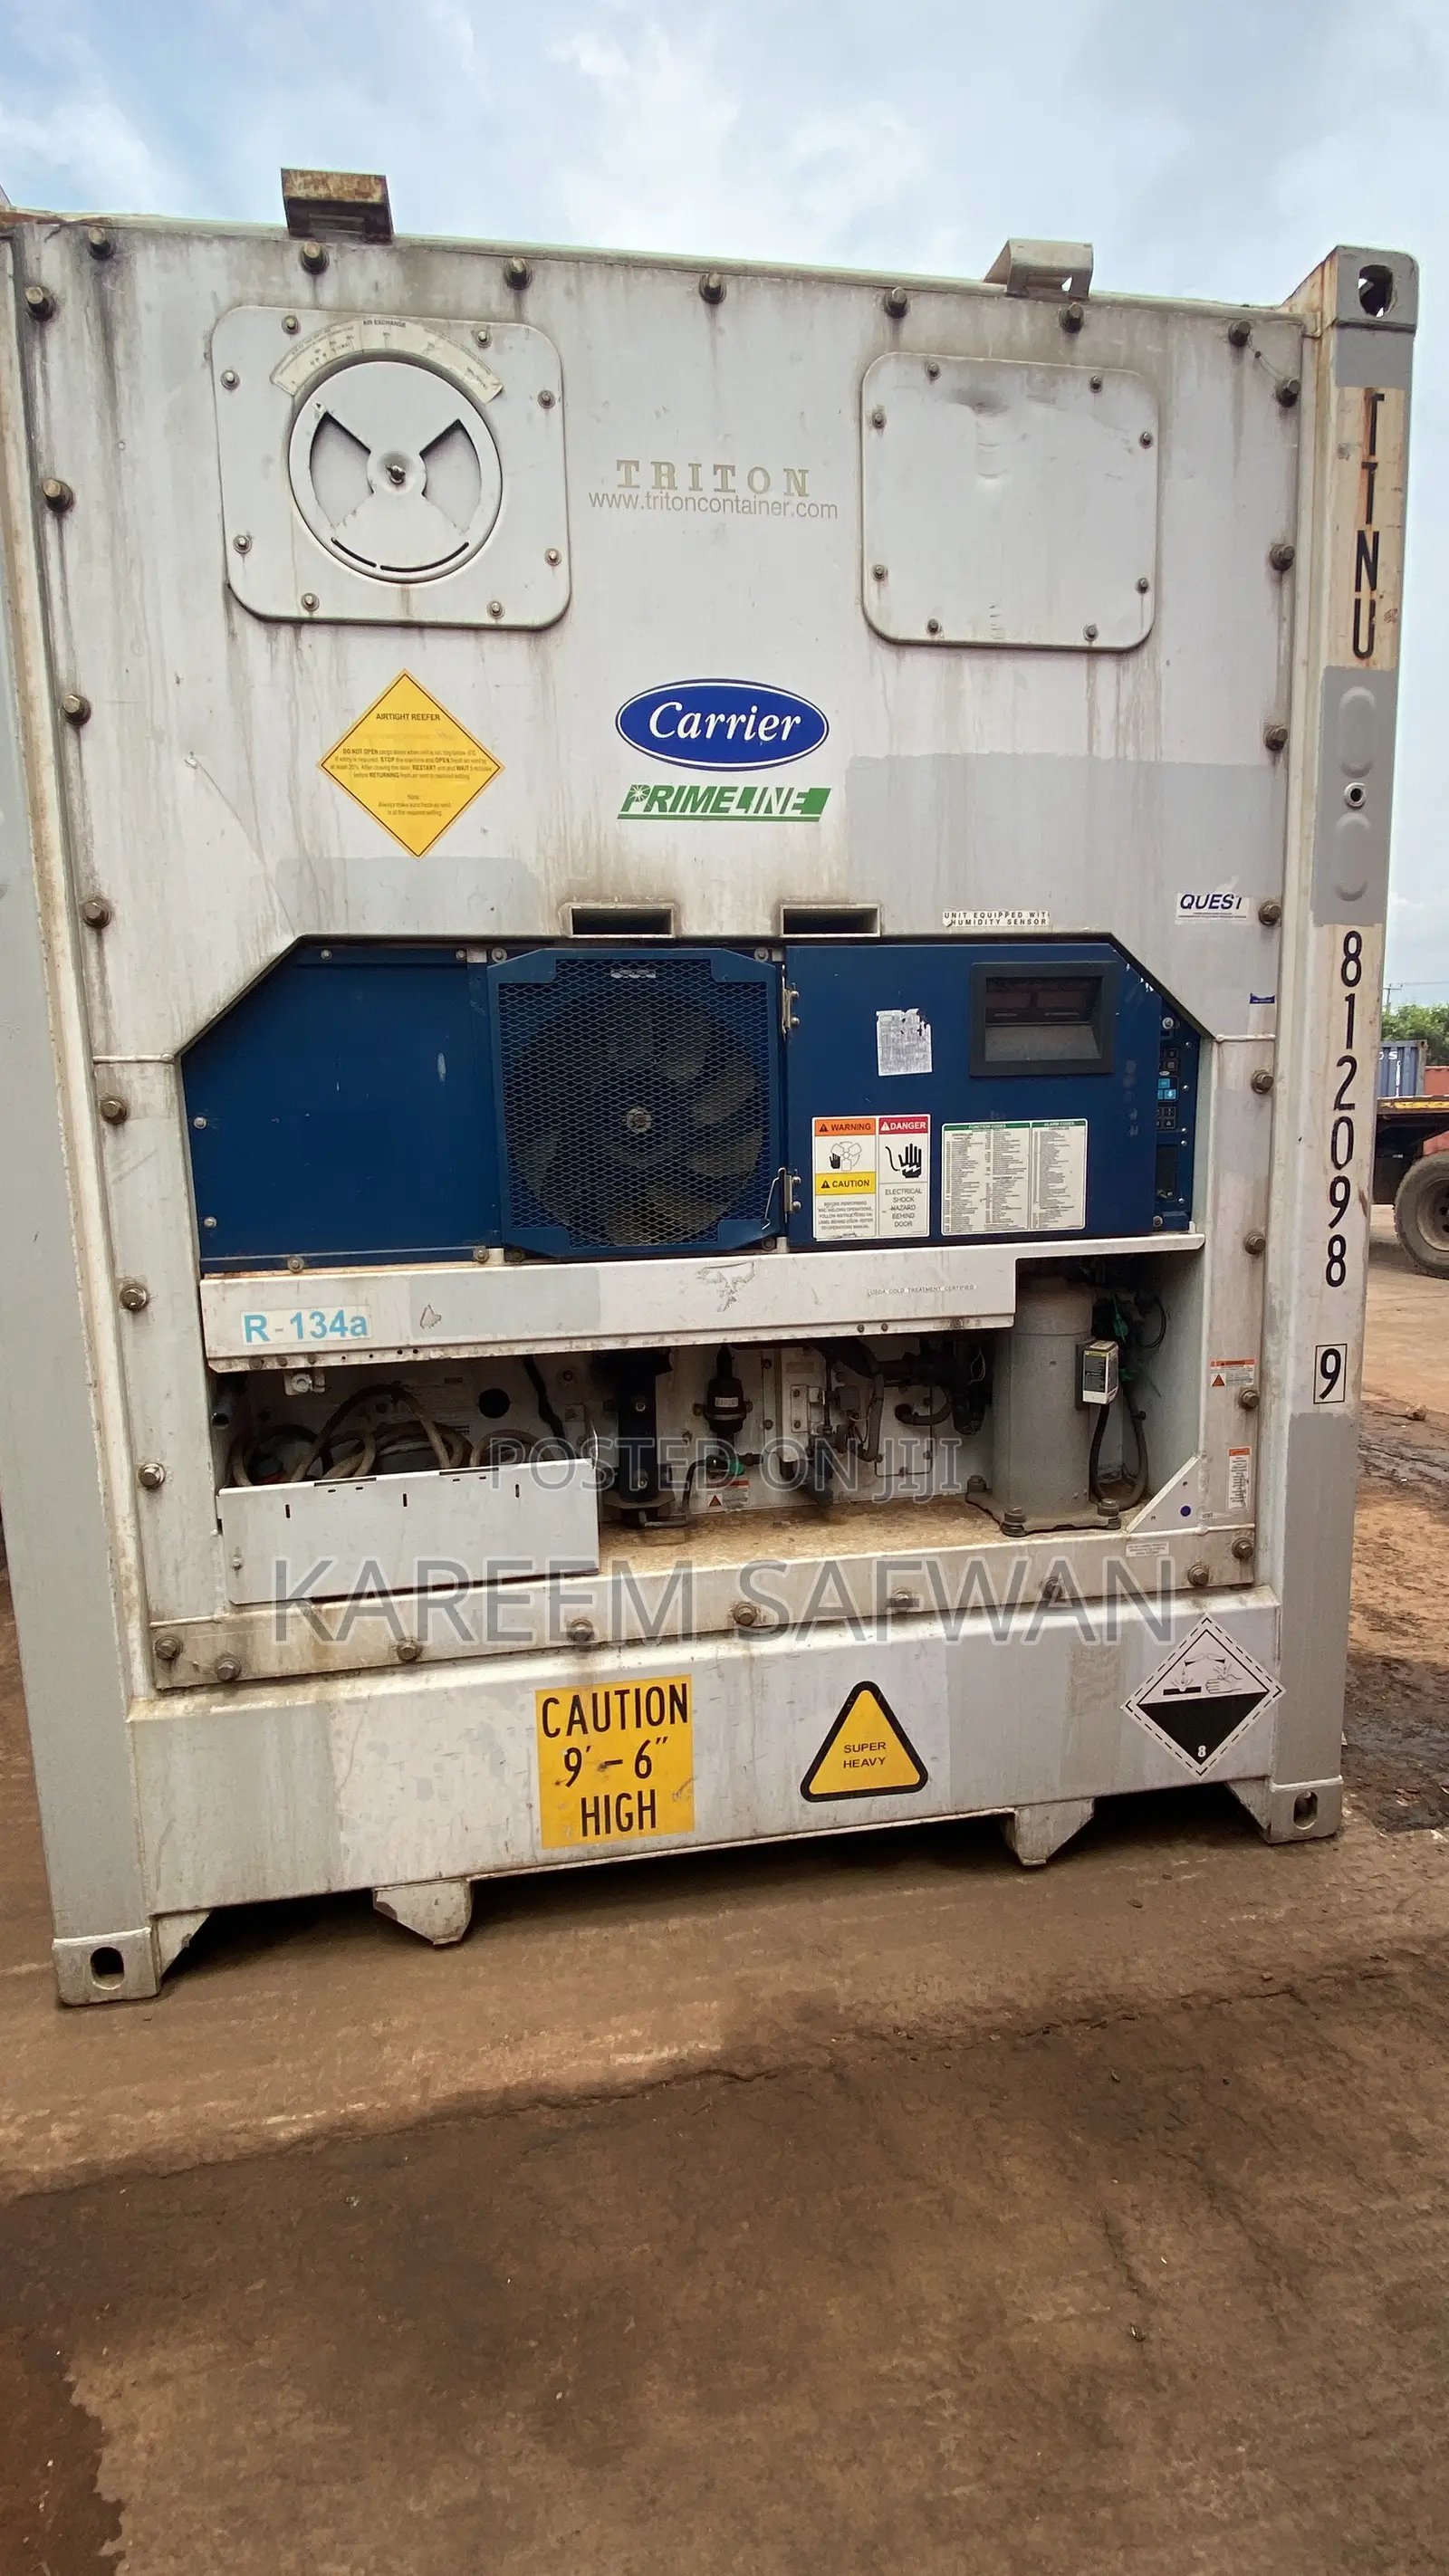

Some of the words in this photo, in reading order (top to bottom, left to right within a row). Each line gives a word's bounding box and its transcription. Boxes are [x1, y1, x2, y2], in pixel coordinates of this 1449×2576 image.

[616, 459, 811, 497] TRITON
[589, 490, 839, 520] www.tritoncontainer.com
[411, 713, 440, 722] REEFER
[648, 702, 801, 742] Carrier
[620, 784, 831, 815] PRIMELINE
[1325, 930, 1363, 1288] 812098
[830, 1123, 871, 1131] WARNING
[890, 1122, 926, 1130] DANGER
[831, 1179, 869, 1188] CAUTION
[1319, 1347, 1341, 1401] 9
[542, 1682, 689, 1738] CAUTION
[843, 1740, 887, 1755] SUPER
[843, 1756, 887, 1769] HEAVY
[1197, 1745, 1206, 1757] 8
[581, 1788, 657, 1837] HIGH
